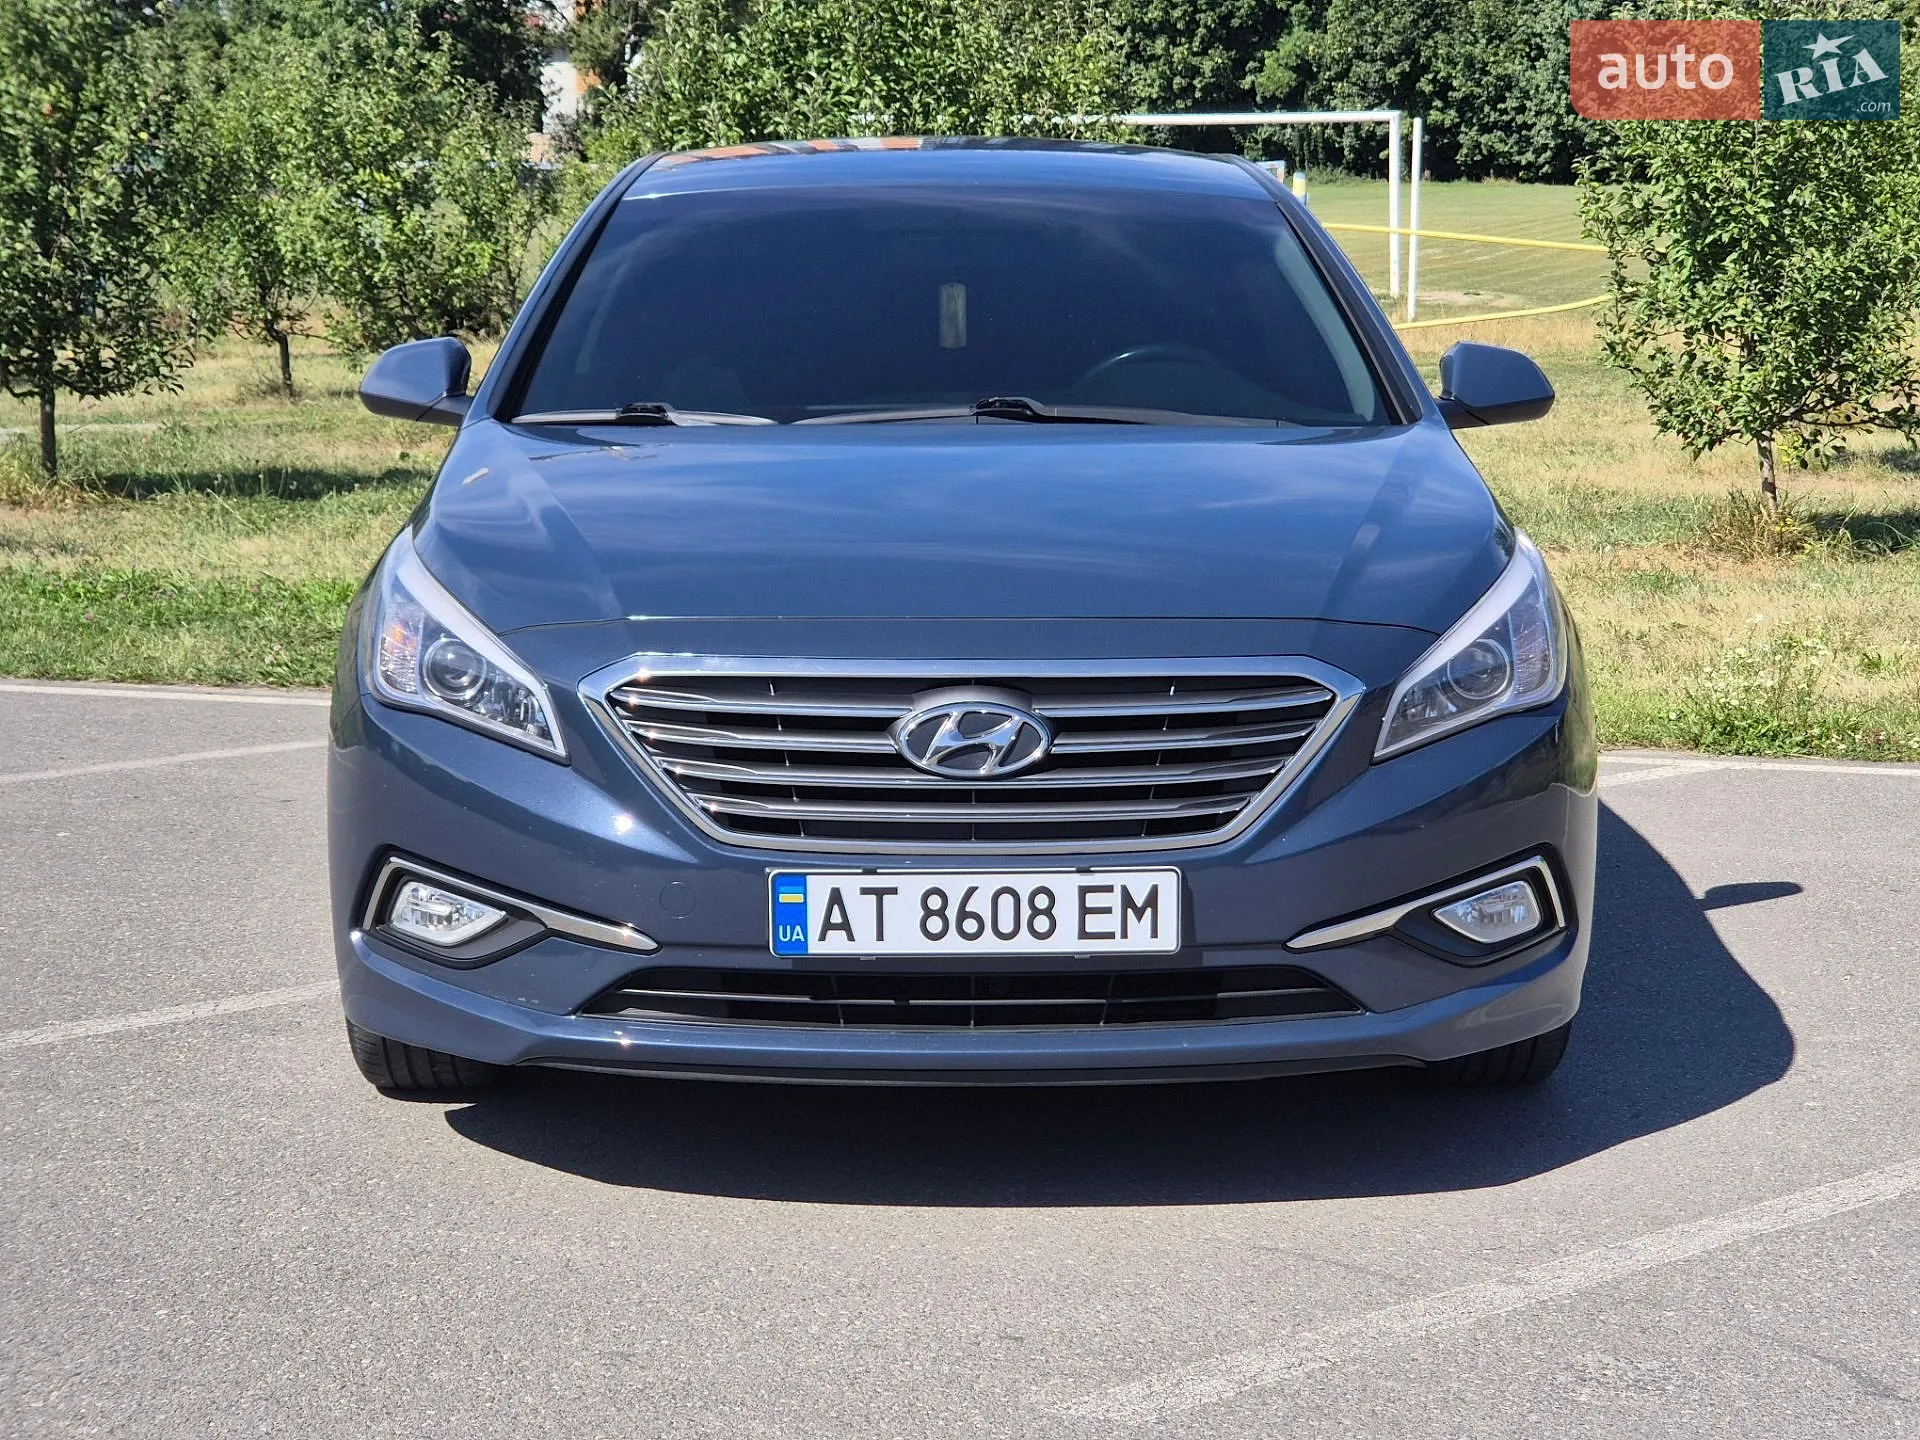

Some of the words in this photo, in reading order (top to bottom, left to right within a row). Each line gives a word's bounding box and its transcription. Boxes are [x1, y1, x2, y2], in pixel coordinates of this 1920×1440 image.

[817, 886, 899, 942] AT
[919, 885, 1057, 942] 8608
[1076, 884, 1159, 941] EM
[779, 924, 805, 943] UA
